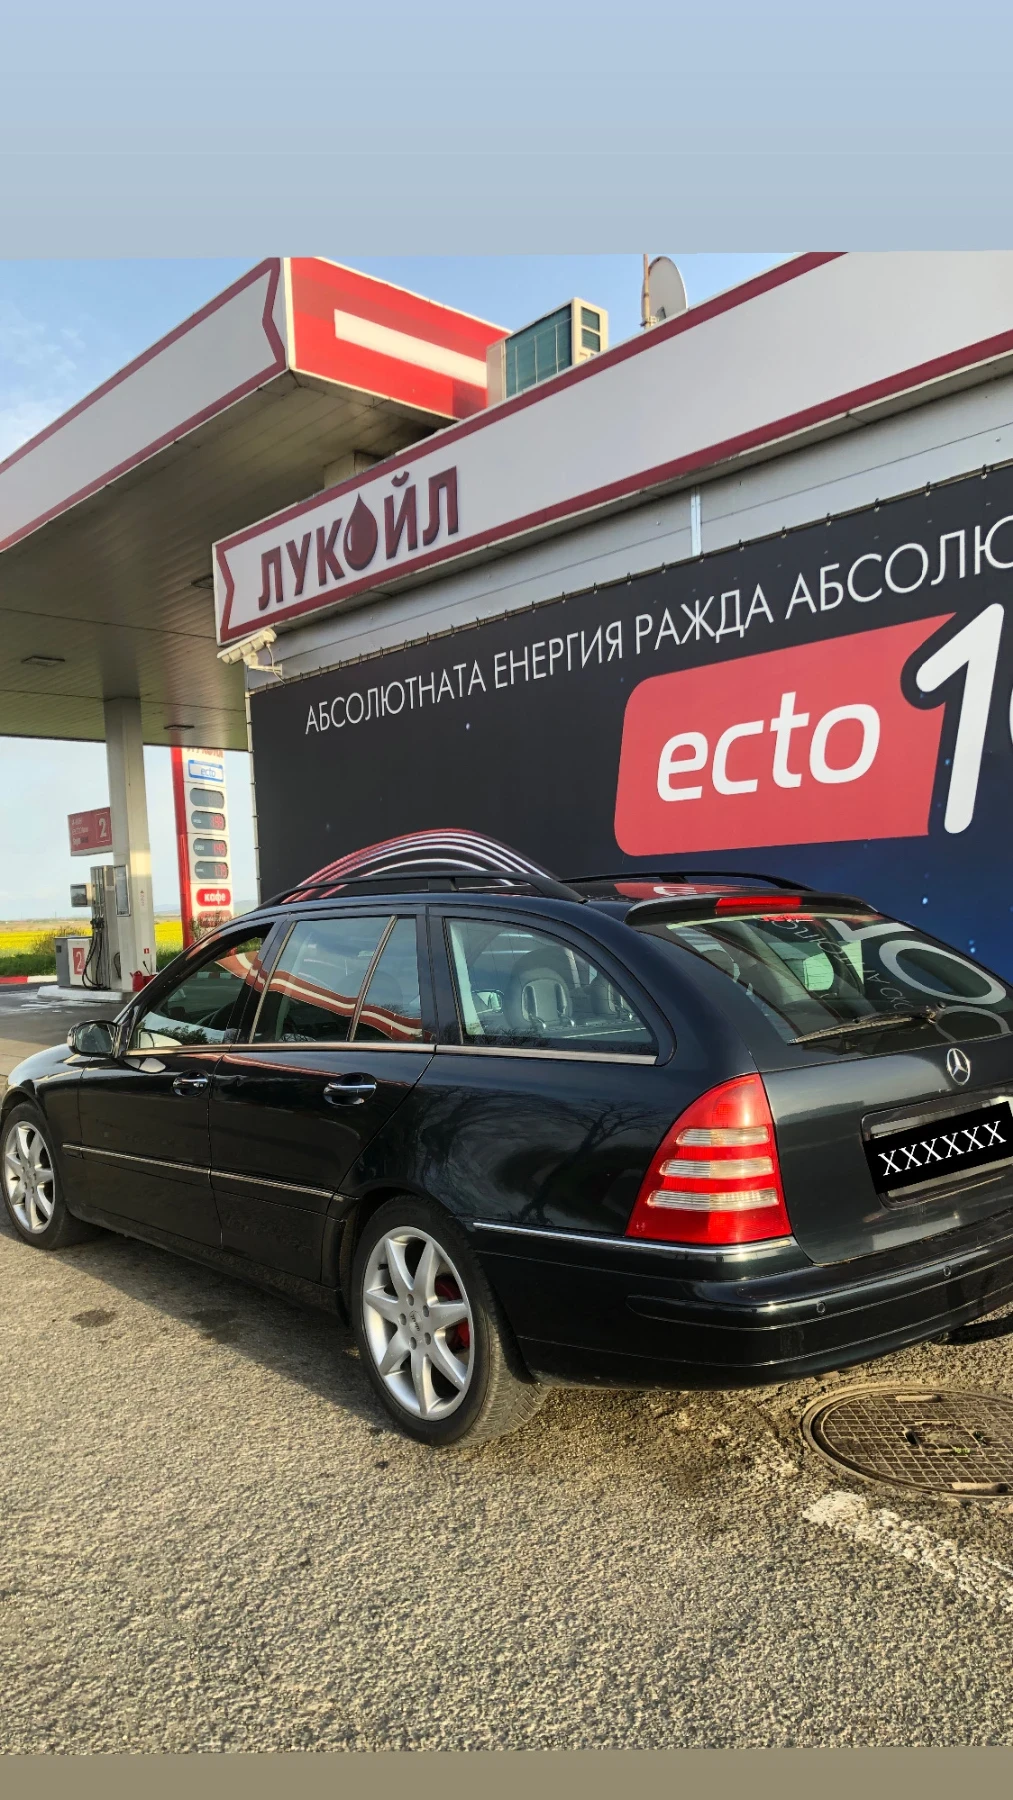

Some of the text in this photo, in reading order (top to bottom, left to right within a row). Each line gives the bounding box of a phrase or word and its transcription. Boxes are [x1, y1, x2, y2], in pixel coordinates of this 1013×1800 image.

[257, 465, 460, 612] ЛУКОЙЛ
[305, 659, 488, 735] АБСОЛЮТНАТА
[494, 620, 623, 690] ЕНЕРГИЯ
[635, 583, 775, 656] РАЖДА
[656, 691, 881, 803] ecto
[98, 817, 107, 838] 2
[204, 890, 226, 905] кафе
[75, 951, 83, 972] 2
